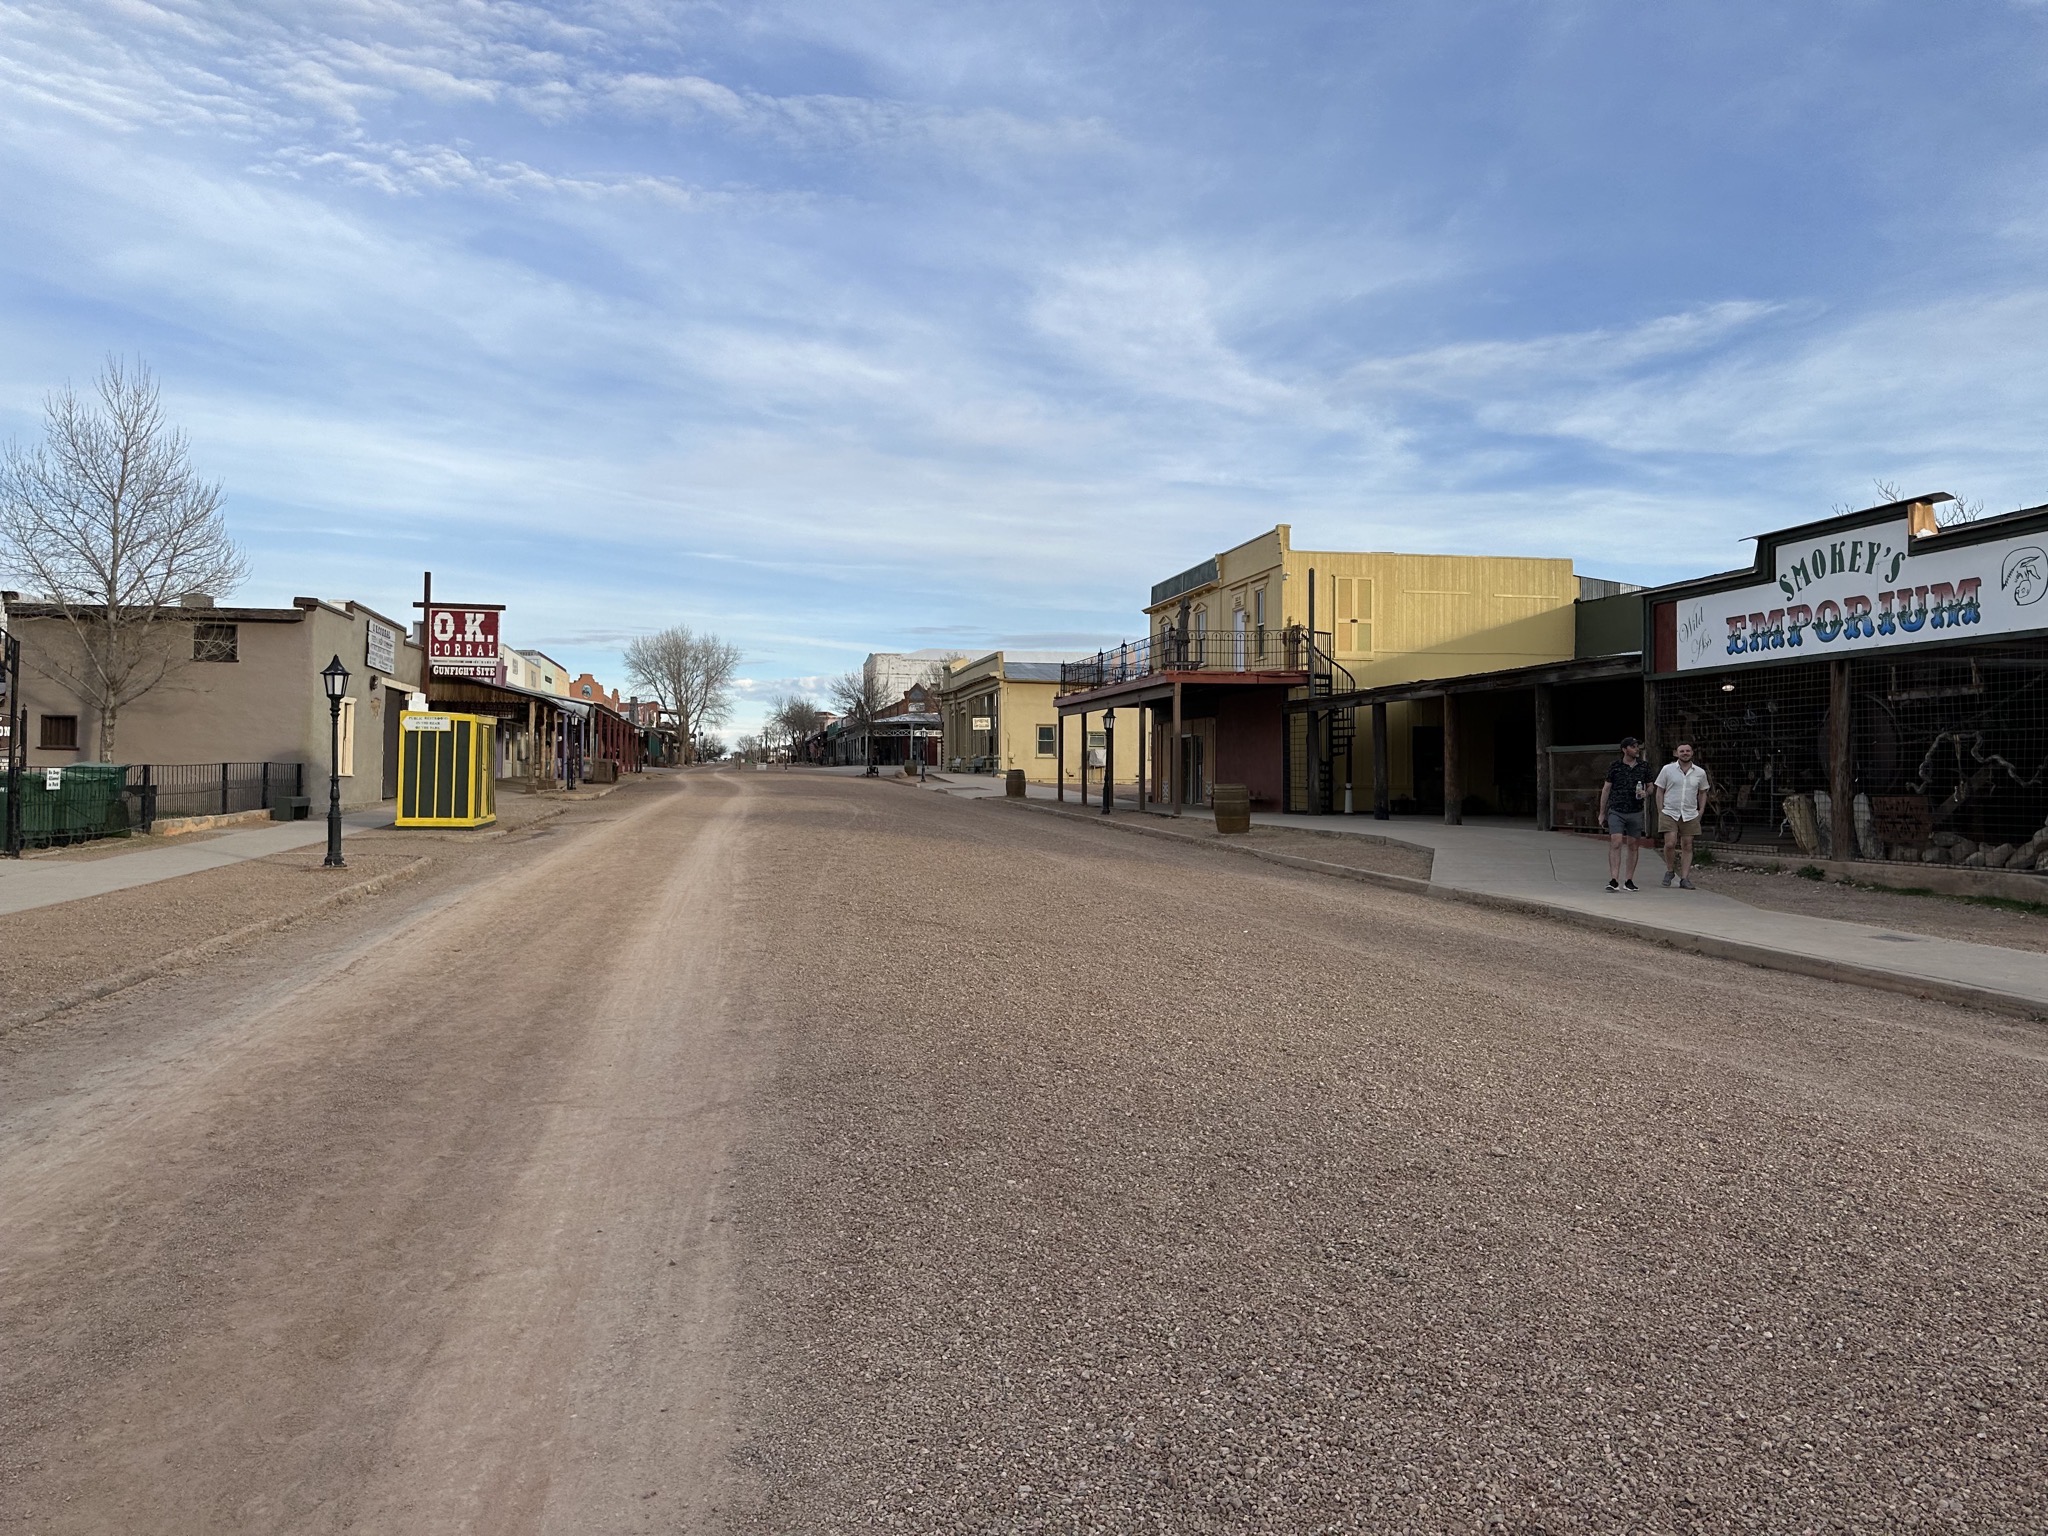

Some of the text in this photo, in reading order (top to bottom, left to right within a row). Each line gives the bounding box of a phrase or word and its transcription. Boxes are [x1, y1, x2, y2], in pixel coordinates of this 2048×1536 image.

[1779, 540, 1906, 602] SMOKEY'S
[433, 612, 494, 642] O.K.
[1678, 602, 1704, 643] Wild
[1725, 577, 1982, 656] EMPORIUM
[433, 643, 495, 657] CORRAL
[1691, 628, 1713, 664] Ass
[433, 665, 496, 677] GUNFIGHT SITE
